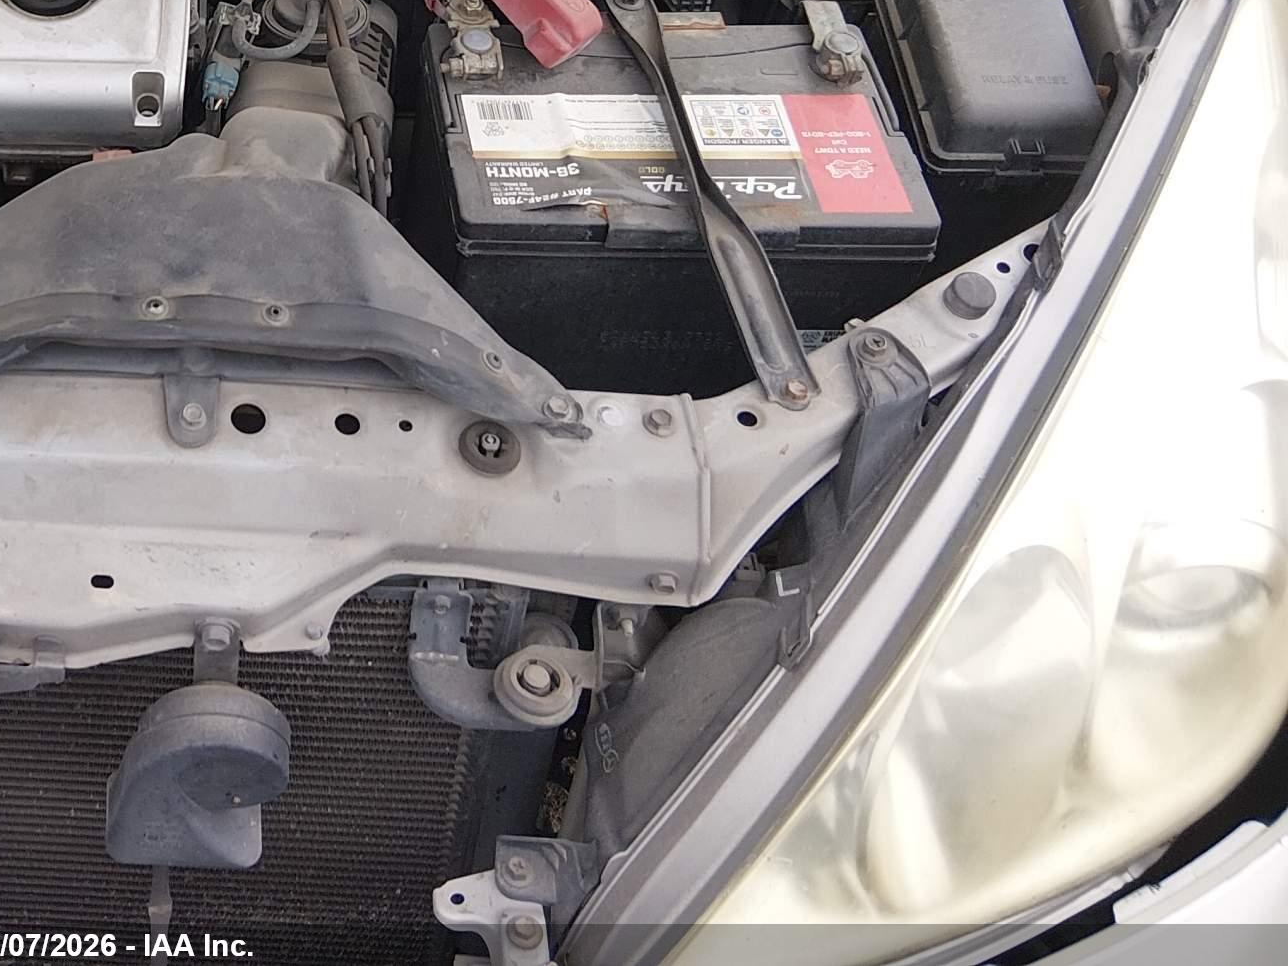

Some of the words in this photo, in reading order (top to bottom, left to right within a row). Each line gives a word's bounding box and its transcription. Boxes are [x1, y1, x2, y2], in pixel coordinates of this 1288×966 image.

[981, 74, 1021, 84] RELAY
[1035, 74, 1069, 84] FUSE
[485, 163, 580, 178] 36-MONTH
[561, 186, 593, 198] PART
[732, 176, 803, 200] Pep
